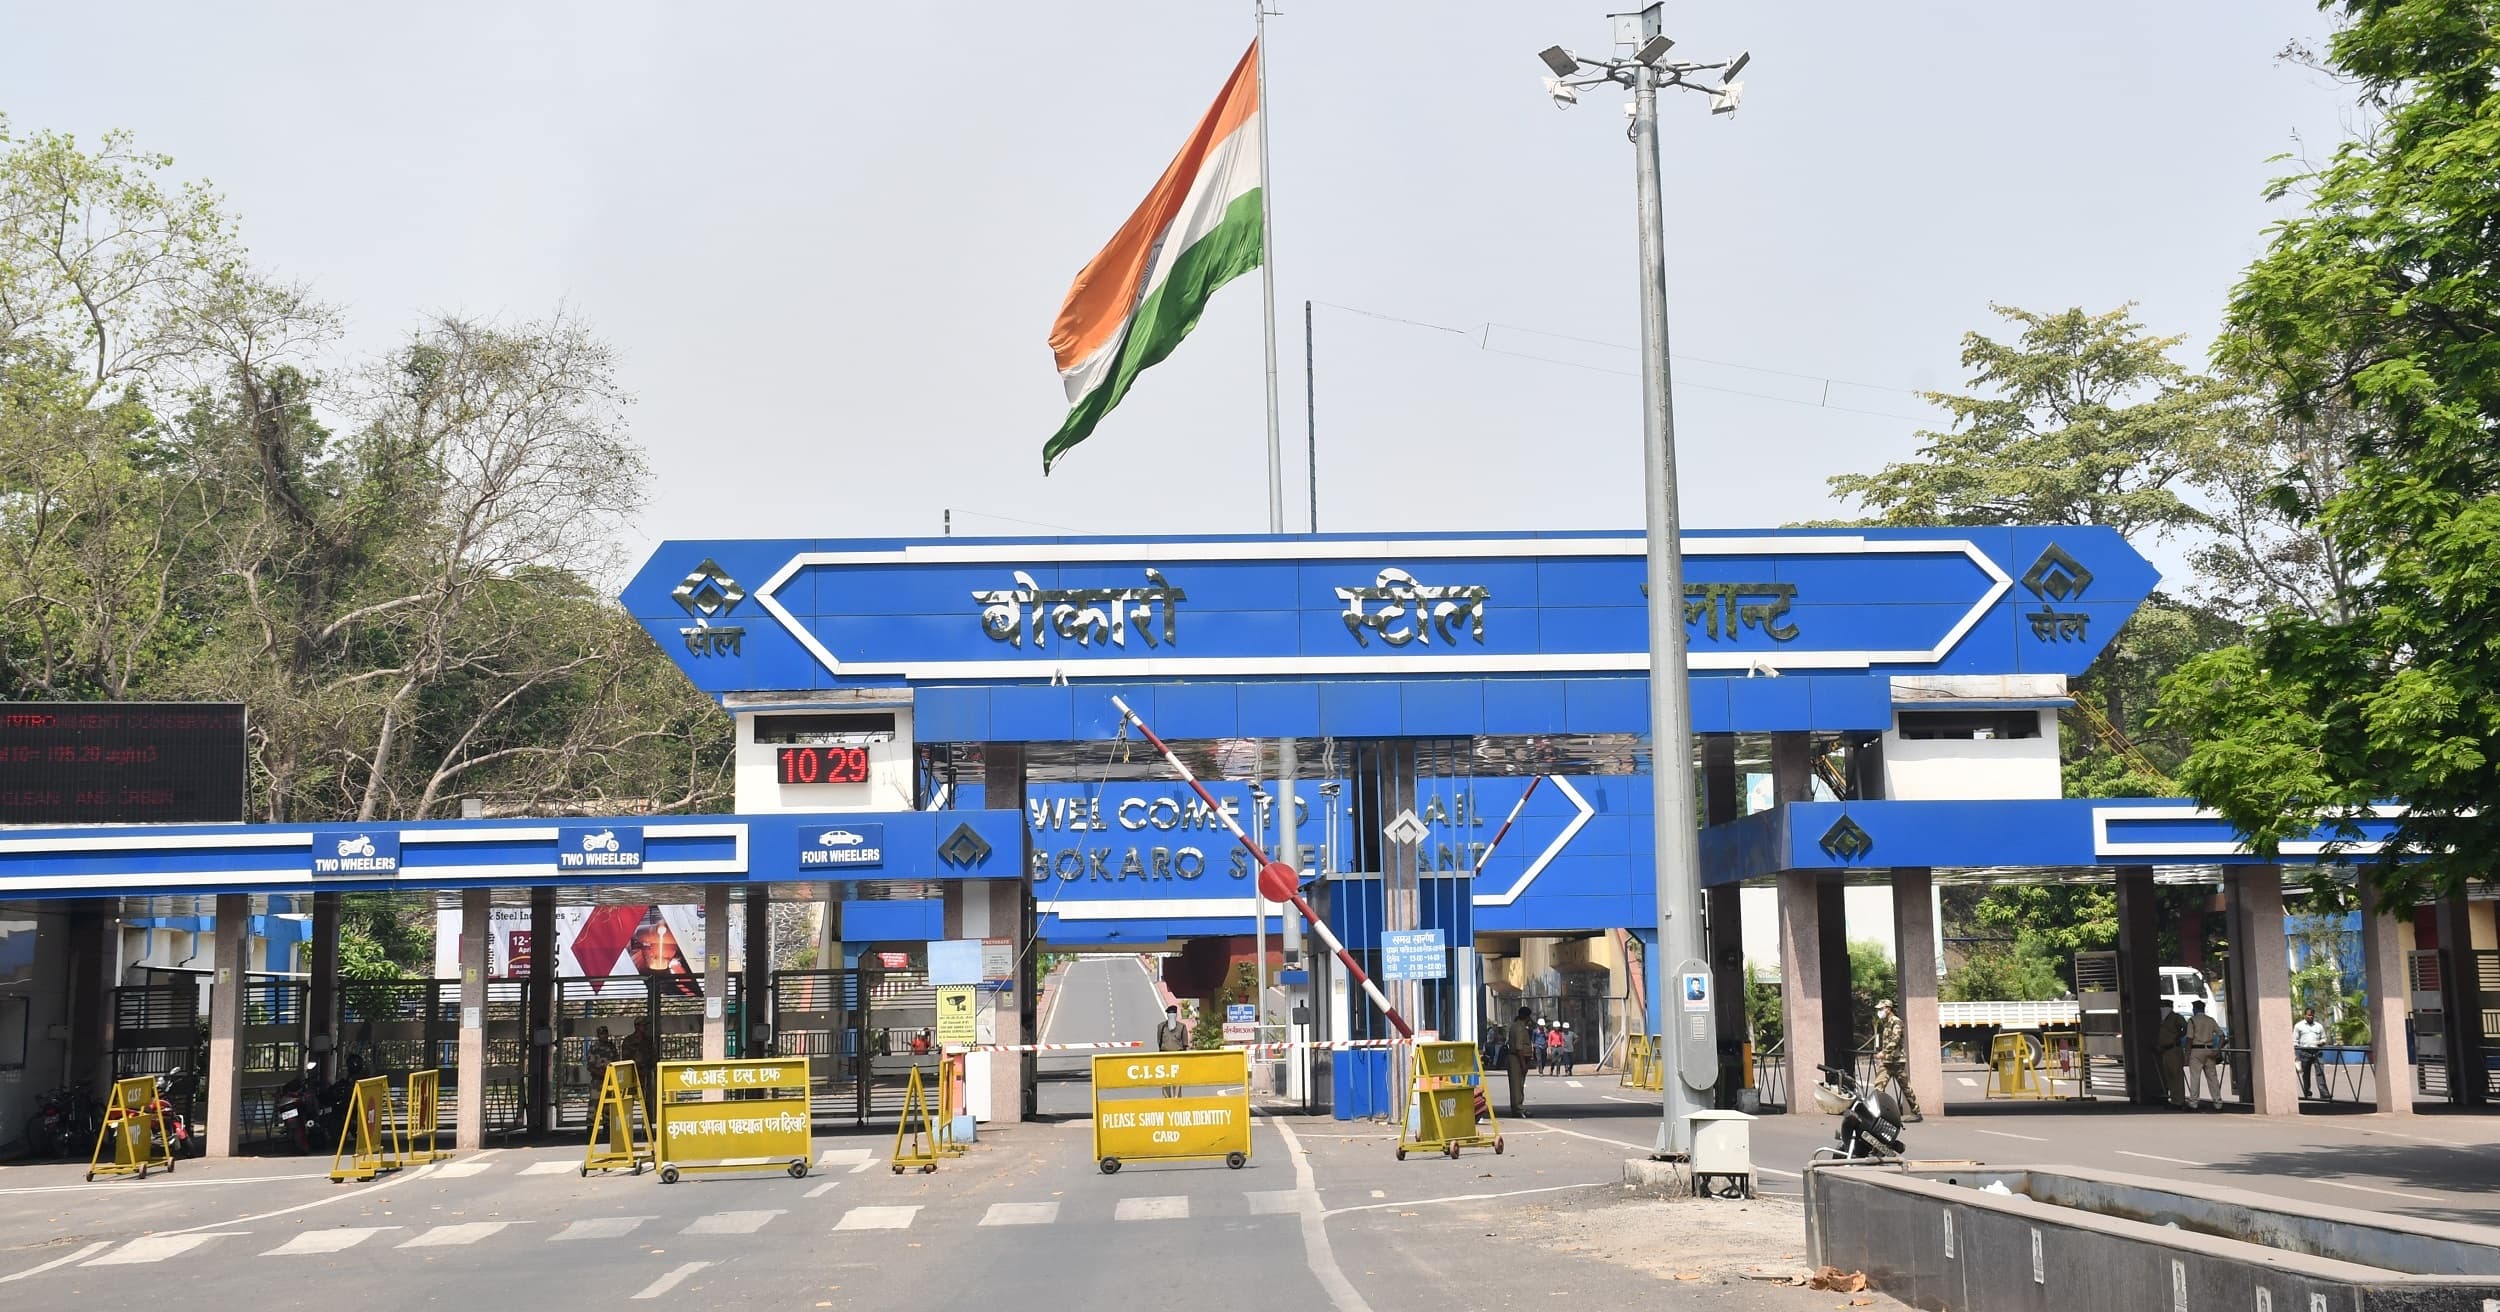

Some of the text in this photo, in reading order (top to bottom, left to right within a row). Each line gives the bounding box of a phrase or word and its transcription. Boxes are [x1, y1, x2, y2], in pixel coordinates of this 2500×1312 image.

[971, 567, 1799, 648] बोकारो स्टील लान्ट
[2026, 604, 2090, 642] सेल
[680, 618, 746, 657] सेल
[781, 748, 867, 783] 10 29
[316, 857, 396, 872] TWO WHEELERS
[561, 852, 640, 866] TWO WHEELERS
[802, 848, 880, 864] FOUR WHEELERS
[1032, 847, 1205, 881] BOKARO
[496, 911, 517, 921] Steel
[1439, 1098, 1456, 1118] STOP
[667, 1120, 698, 1139] कृपया
[699, 1119, 727, 1136] अपना
[728, 1118, 764, 1135] पहचान
[764, 1117, 781, 1133] पत्र
[1102, 1109, 1232, 1129] PLEASE SHOW YOUR IDENTITY
[1152, 1130, 1180, 1143] CARD
